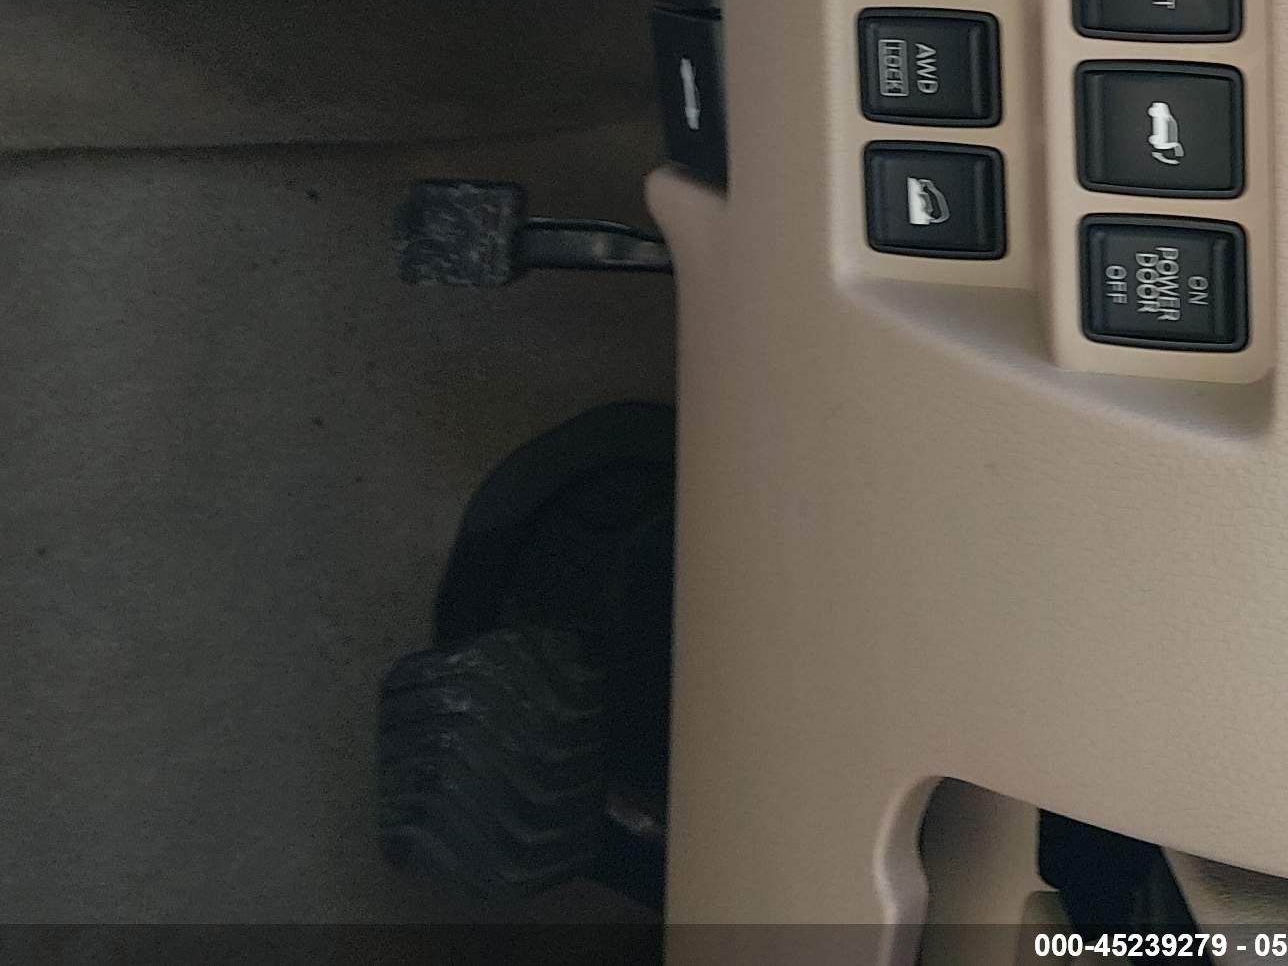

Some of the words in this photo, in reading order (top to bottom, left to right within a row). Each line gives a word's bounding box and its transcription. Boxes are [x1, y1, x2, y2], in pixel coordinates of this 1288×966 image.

[882, 43, 906, 95] LOCK
[914, 43, 939, 94] AWD
[1105, 265, 1128, 304] OFF
[1135, 253, 1161, 313] DOOR
[1155, 247, 1181, 321] POWER
[1187, 275, 1209, 305] ON
